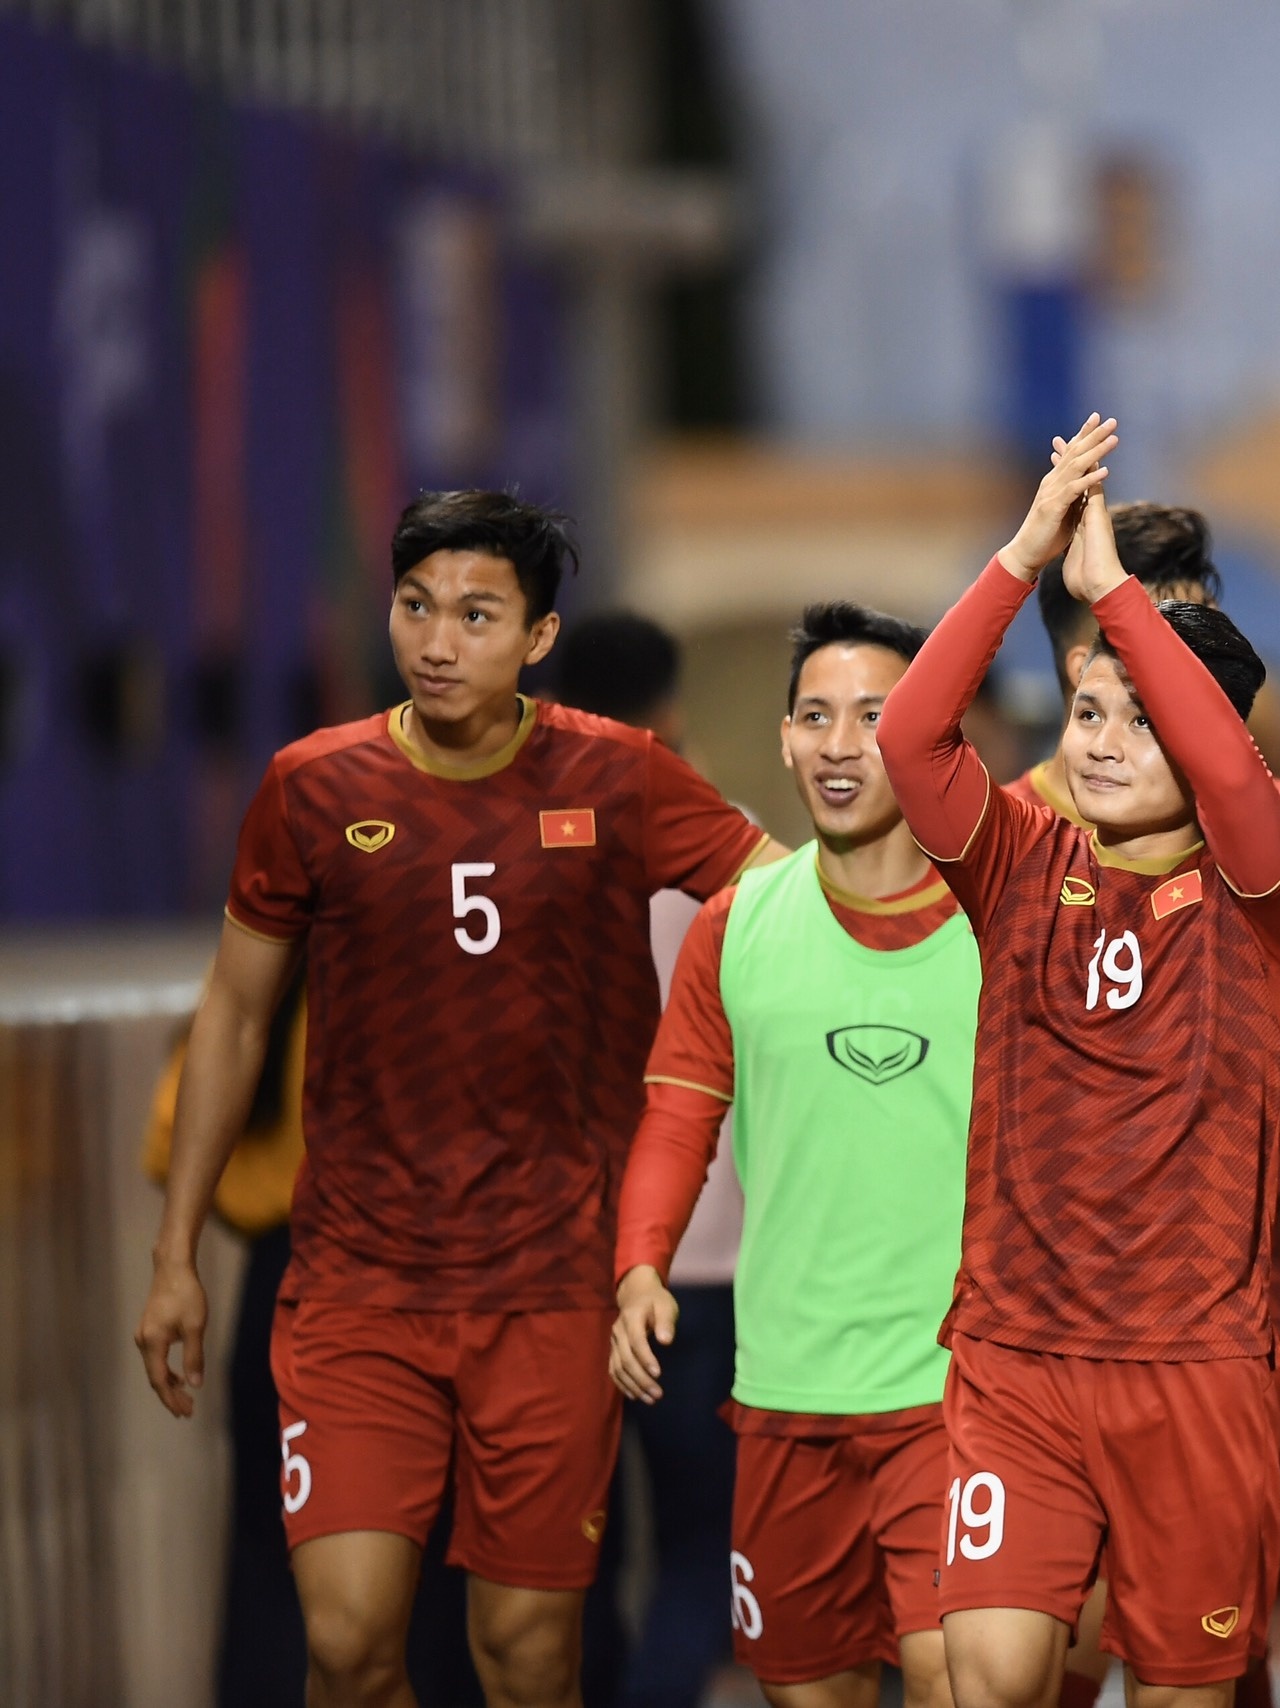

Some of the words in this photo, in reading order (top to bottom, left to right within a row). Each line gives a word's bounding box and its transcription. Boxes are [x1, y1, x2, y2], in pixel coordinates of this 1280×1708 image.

[451, 862, 501, 955] 5
[1085, 927, 1143, 1011] 19
[281, 1420, 312, 1514] 5
[946, 1471, 1006, 1567] 19
[730, 1549, 764, 1641] 6
